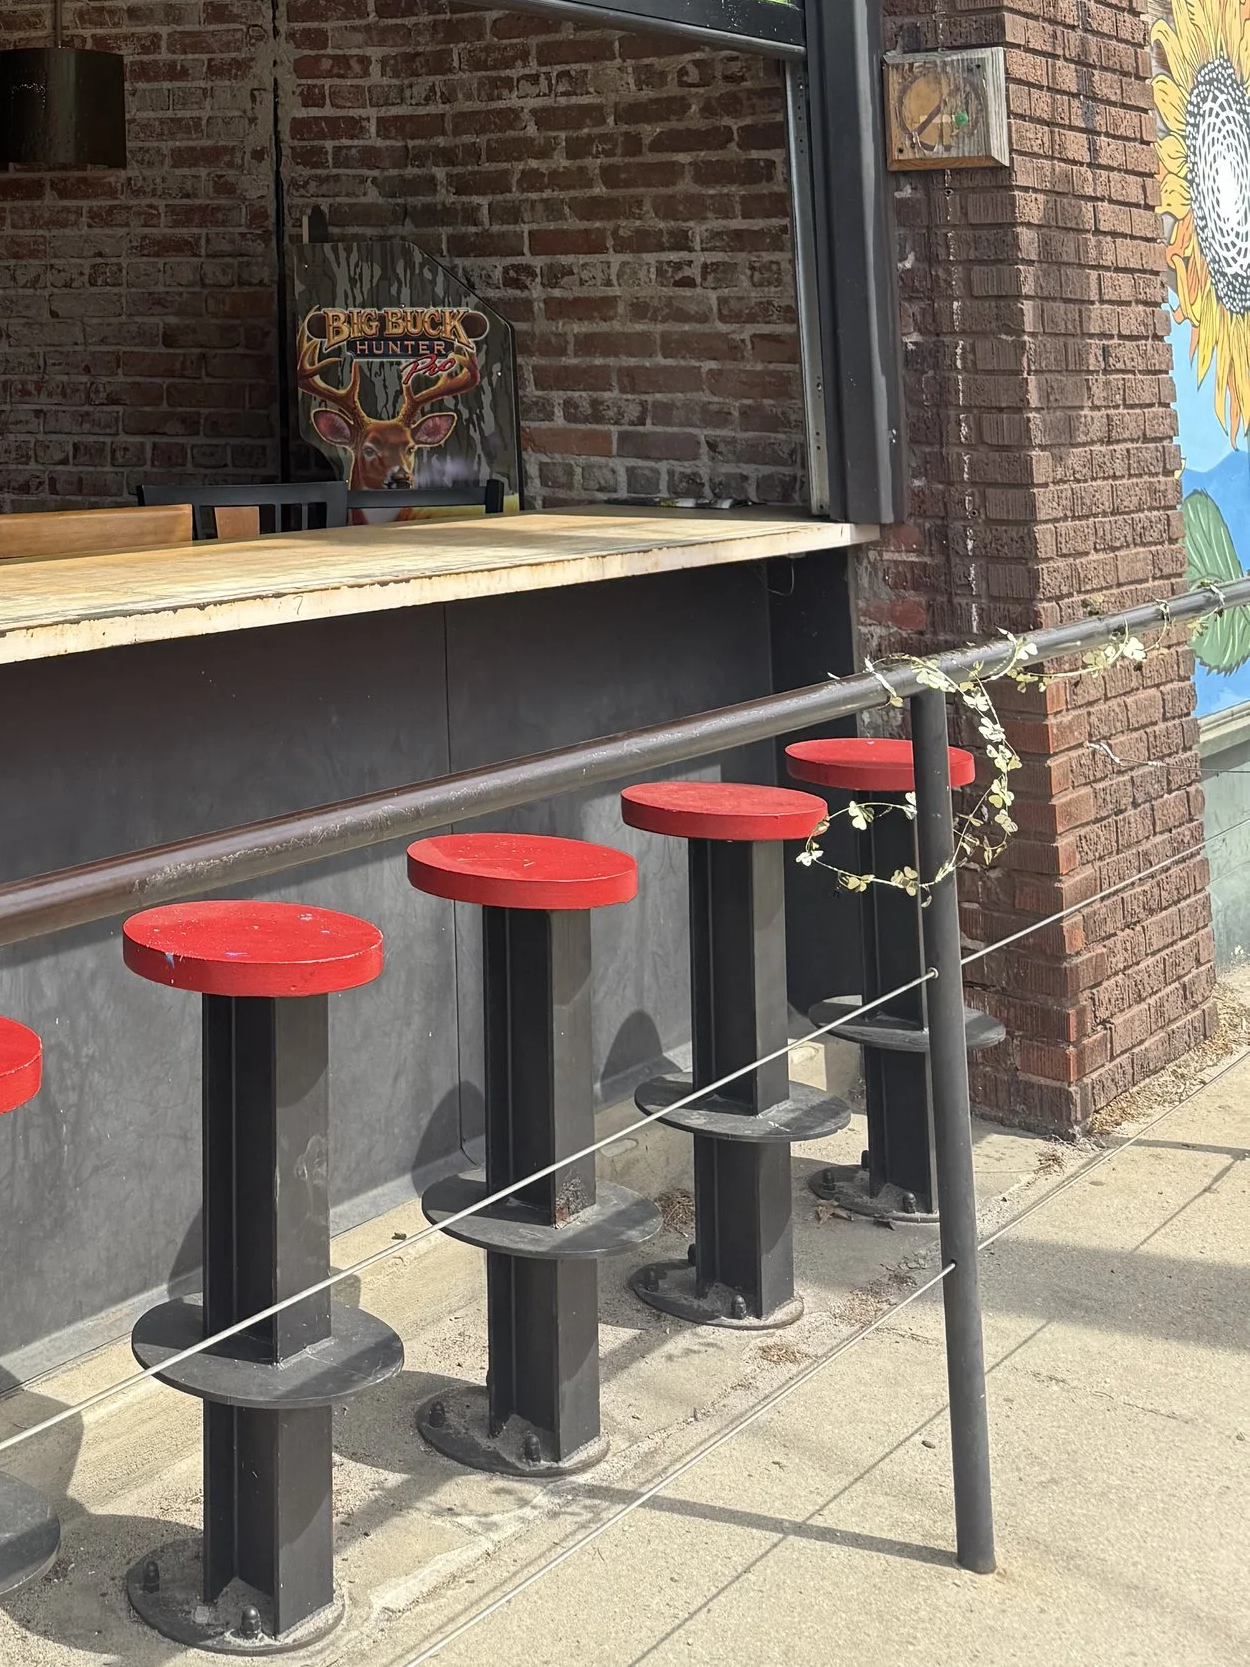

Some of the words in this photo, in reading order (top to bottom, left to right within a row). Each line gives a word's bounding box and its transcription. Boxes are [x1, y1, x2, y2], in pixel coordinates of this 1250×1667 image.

[324, 309, 380, 350] BIG
[384, 308, 476, 351] BUCK
[356, 341, 446, 355] HUNTER
[400, 353, 456, 385] Pro
